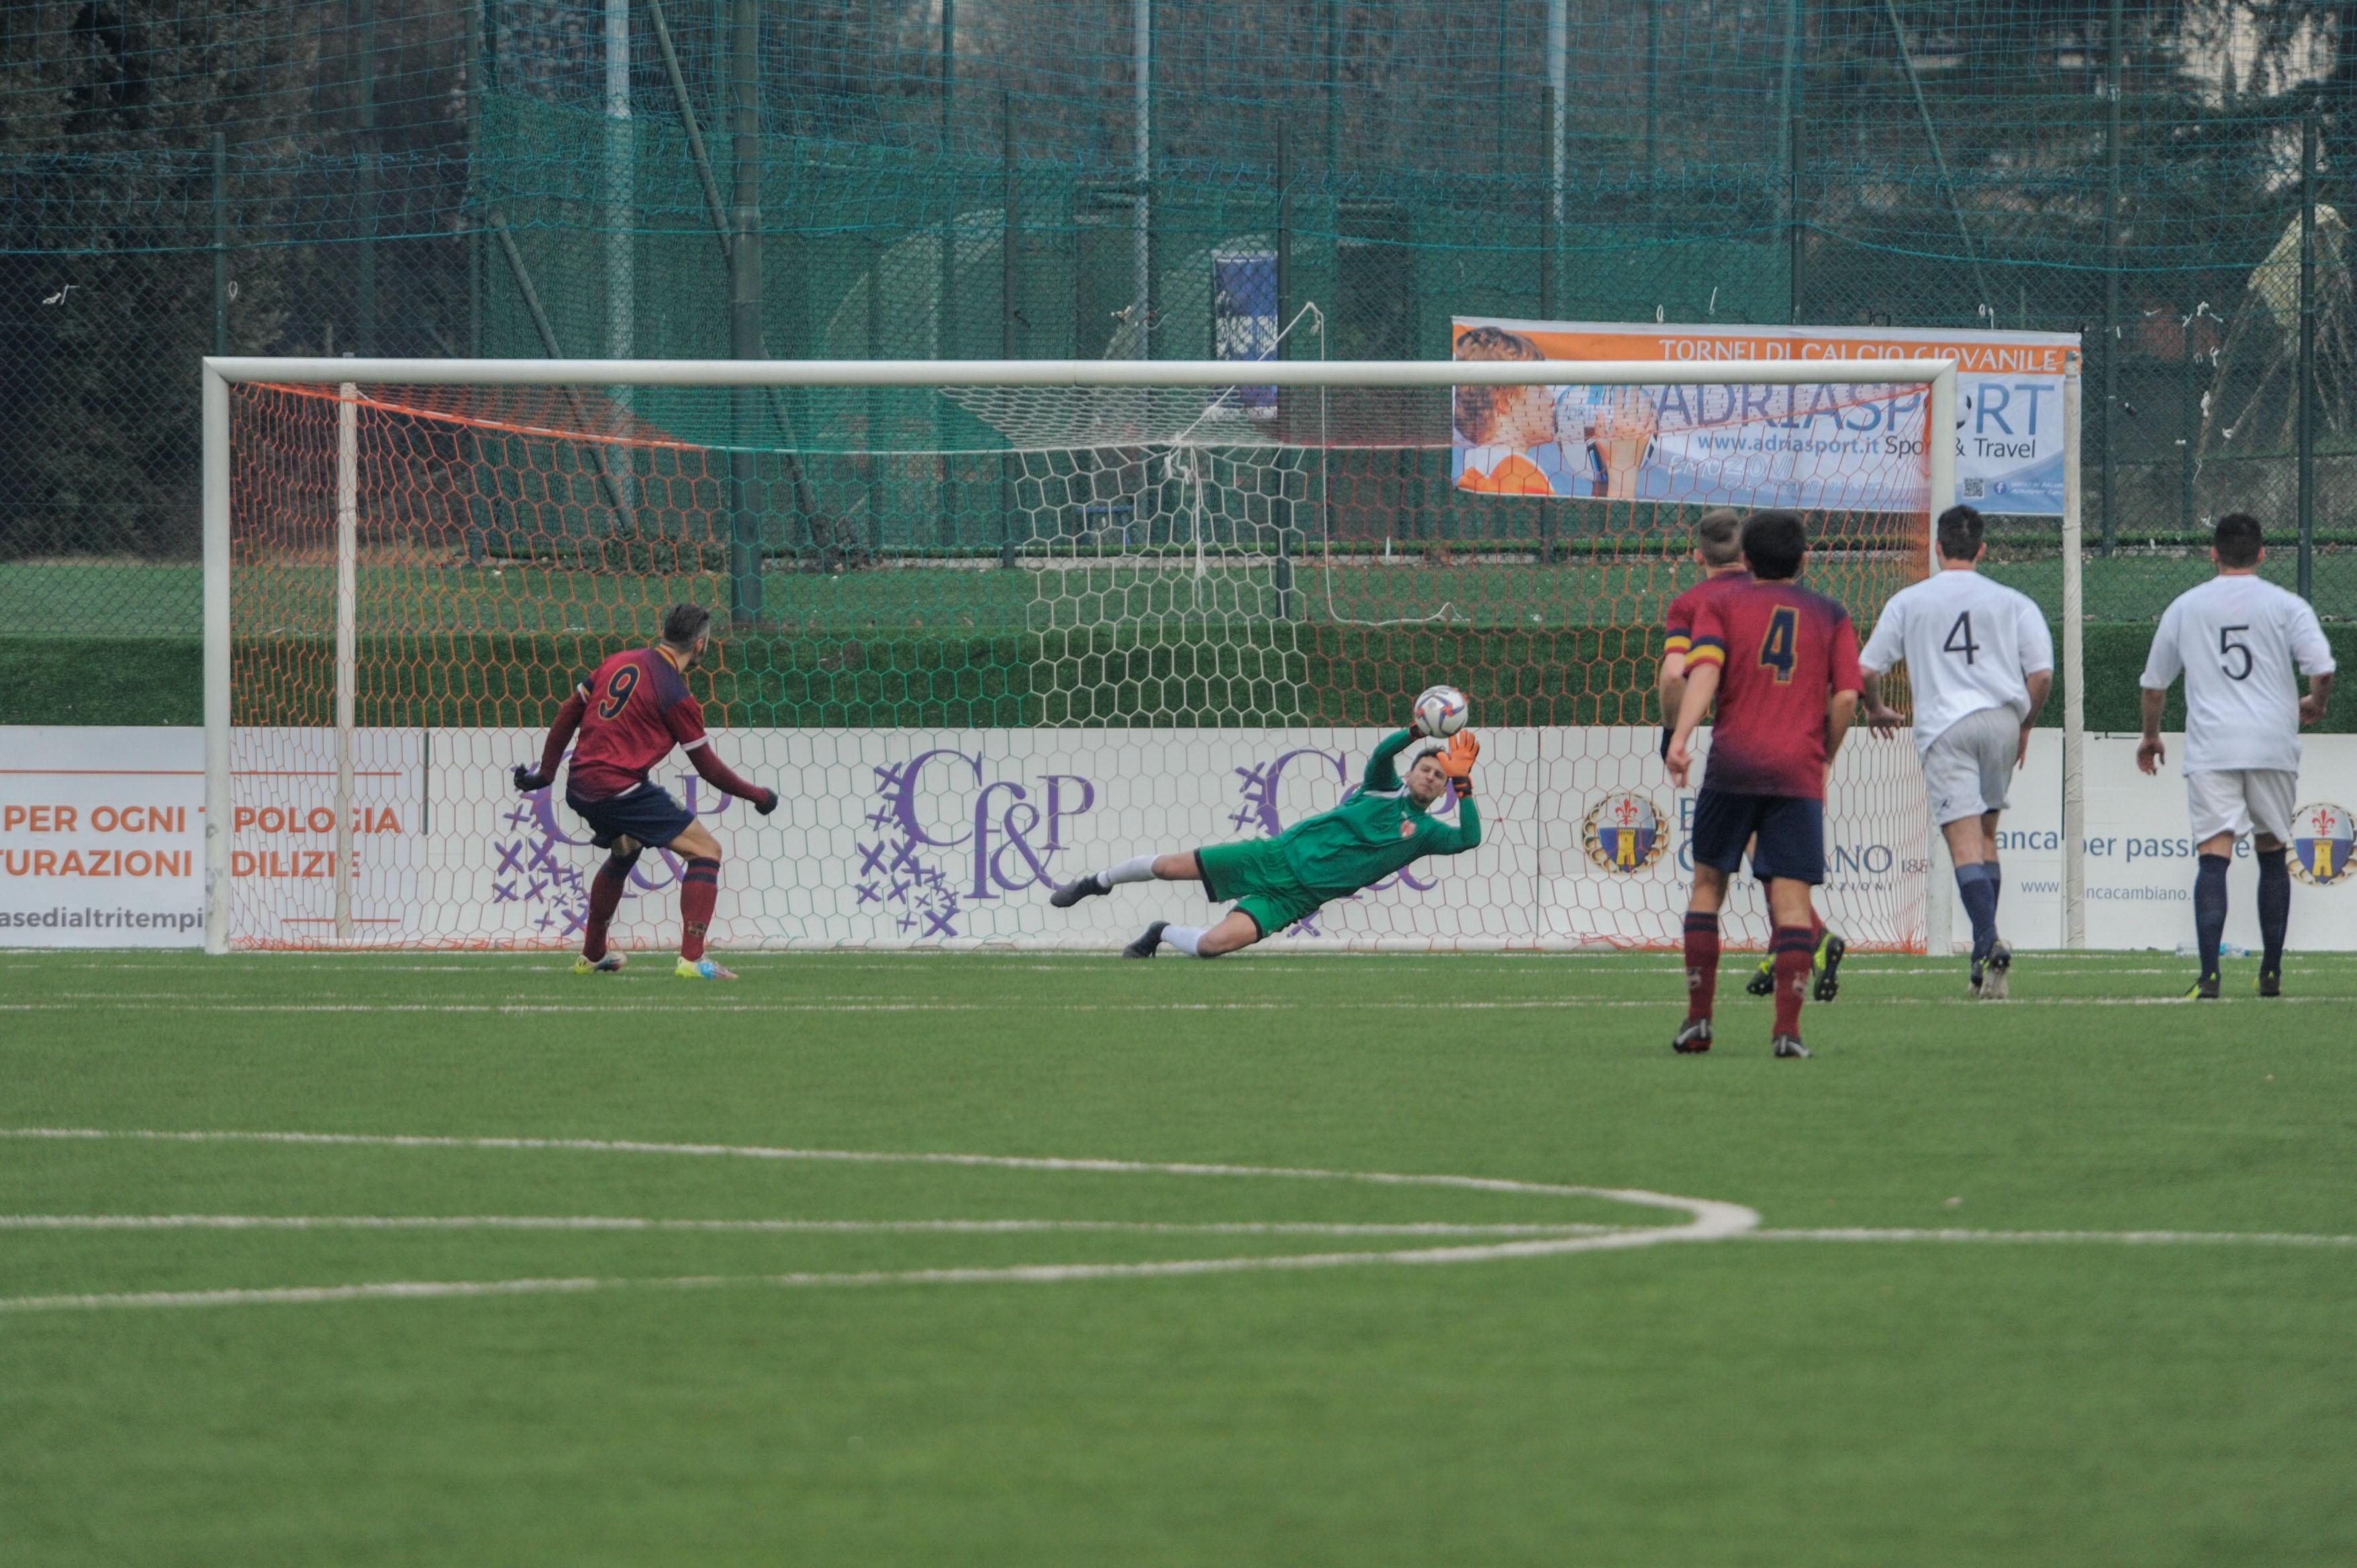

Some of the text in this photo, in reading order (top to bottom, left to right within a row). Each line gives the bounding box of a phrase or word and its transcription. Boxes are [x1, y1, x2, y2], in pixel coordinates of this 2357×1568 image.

[1659, 339, 1755, 360] TORNEI
[1656, 382, 2055, 436] ADRIASPRT
[1697, 433, 1879, 456] www.adriasport.it
[1974, 438, 2036, 458] Travel
[1759, 605, 1799, 685] 4
[1943, 611, 1980, 666] 4
[2219, 624, 2254, 681] 5
[599, 663, 640, 720] 9
[4, 805, 77, 832] PER
[91, 805, 186, 833] OGNI
[1994, 830, 2058, 850] anca
[0, 848, 192, 877] URAZIONI
